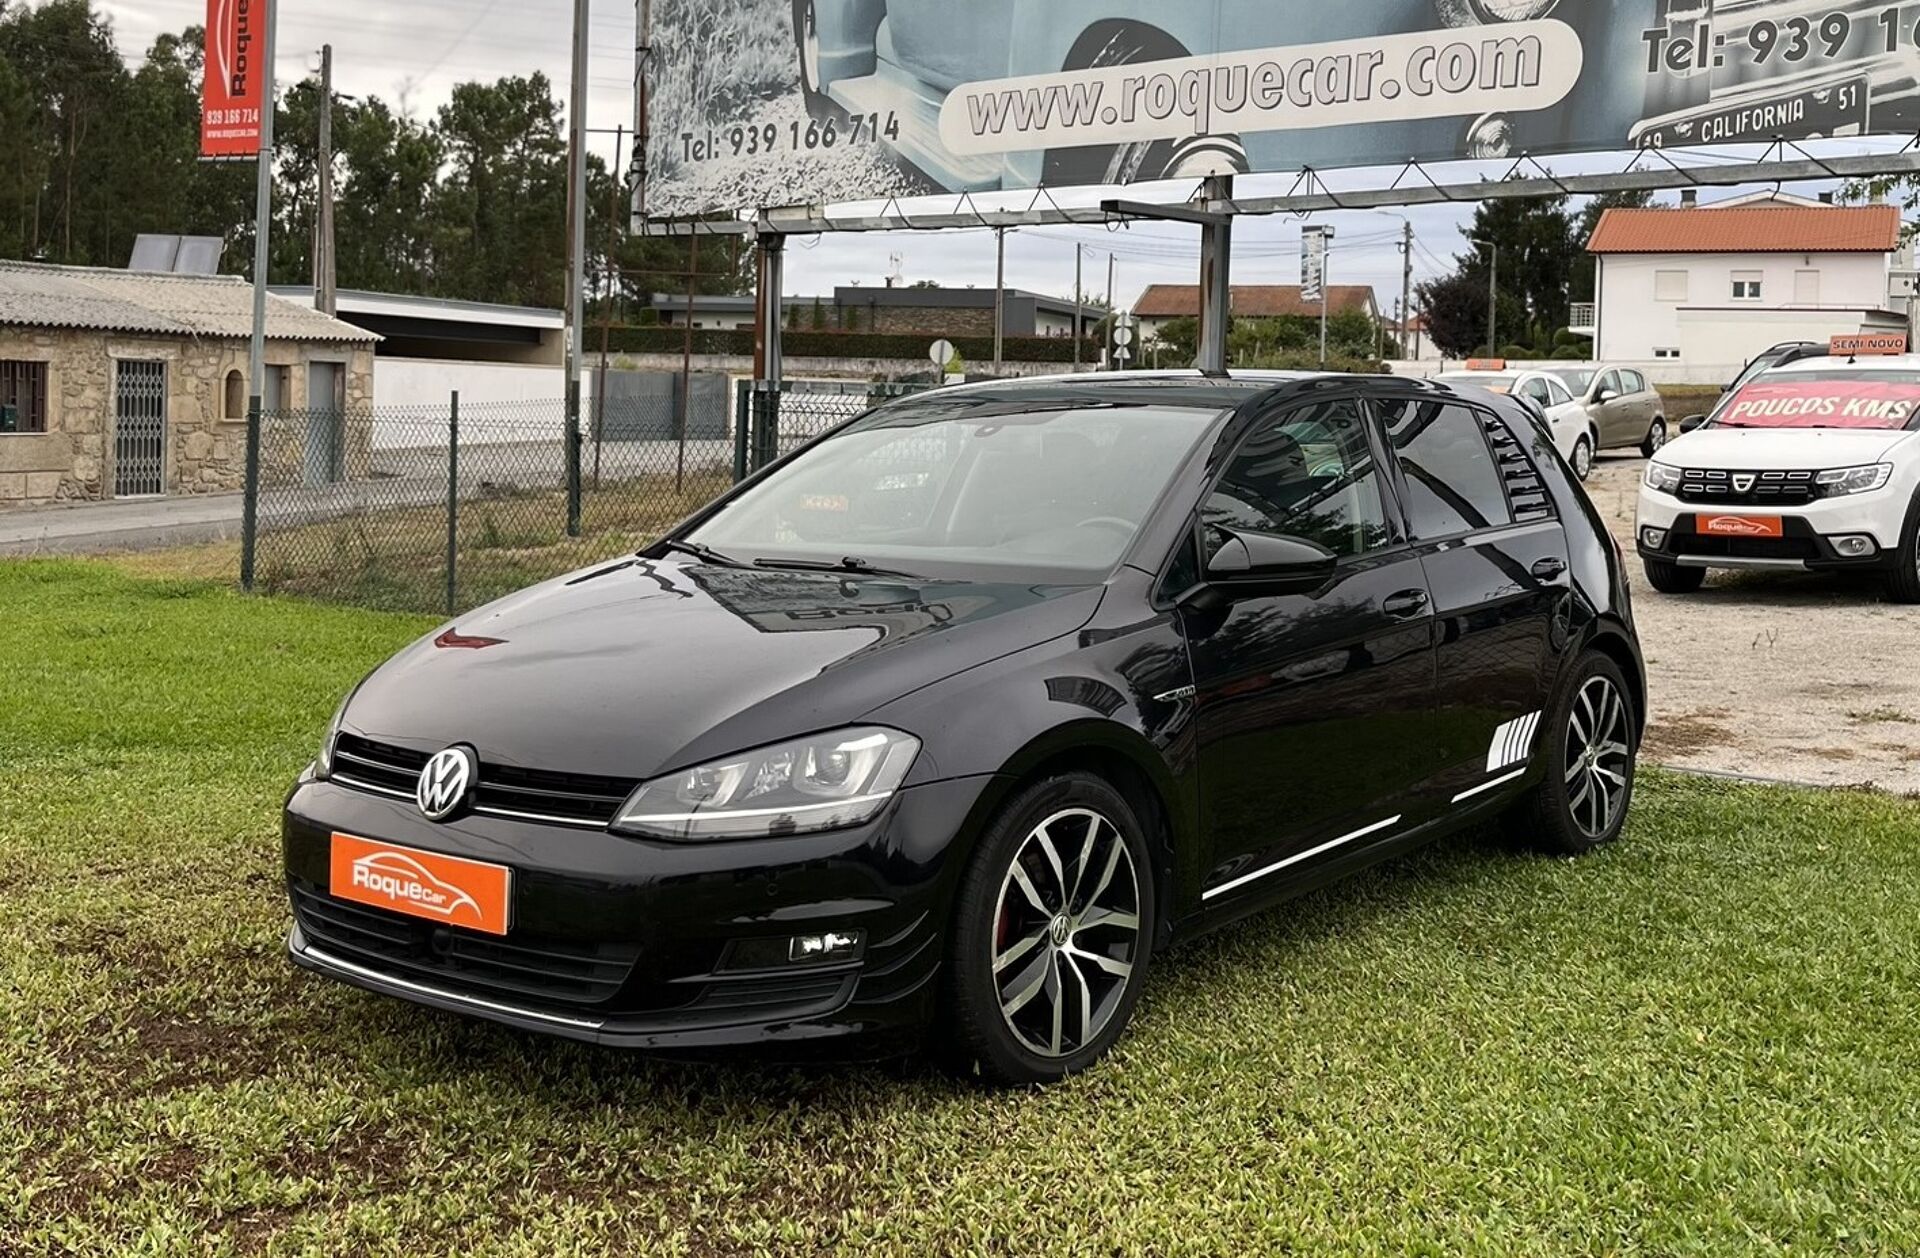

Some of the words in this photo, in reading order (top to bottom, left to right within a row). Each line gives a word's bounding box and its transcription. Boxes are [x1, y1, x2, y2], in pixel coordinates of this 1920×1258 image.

[1642, 23, 1725, 73] Tel:
[1749, 12, 1850, 64] 939
[966, 33, 1543, 135] www.roquecar.com
[206, 110, 222, 125] 939
[224, 109, 240, 124] 166
[242, 108, 259, 123] 714
[682, 130, 720, 162] Tel:
[730, 127, 778, 156] 939
[790, 119, 837, 150] 166
[849, 110, 900, 145] 714
[1702, 99, 1803, 143] CALIFORNIA
[1838, 84, 1856, 110] 51
[1832, 340, 1863, 349] SEMI
[1867, 339, 1904, 349] NOVO
[1729, 397, 1840, 419] POUCOS
[1840, 398, 1912, 419] KMS
